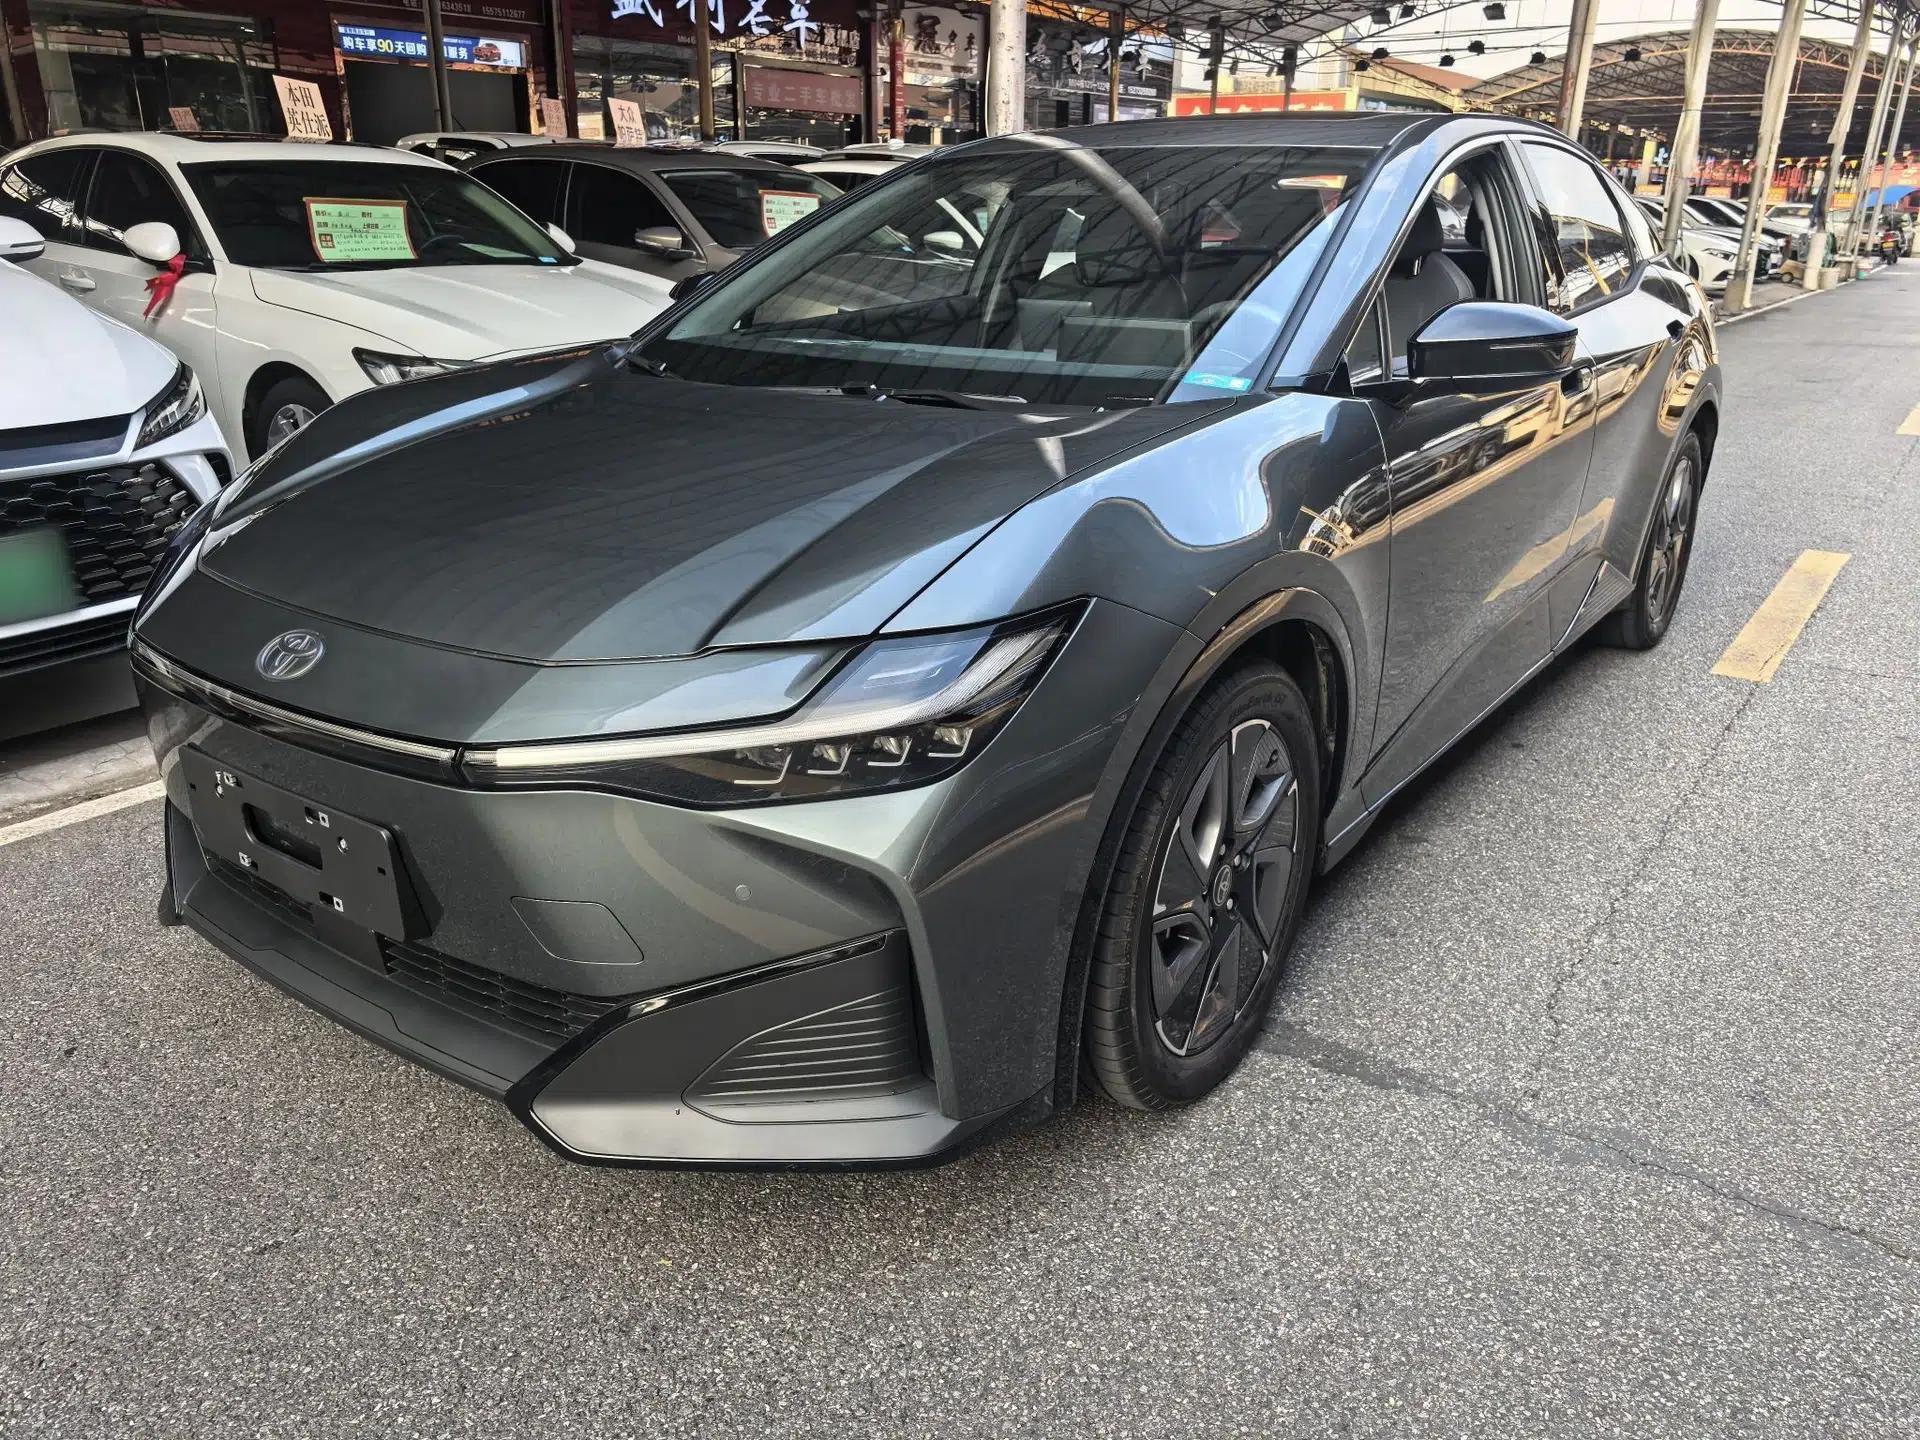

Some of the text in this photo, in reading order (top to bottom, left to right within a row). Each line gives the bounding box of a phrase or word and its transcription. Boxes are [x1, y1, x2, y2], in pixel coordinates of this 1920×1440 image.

[285, 82, 315, 109] 本田
[286, 107, 332, 137] 英仕派
[616, 104, 636, 123] 大众
